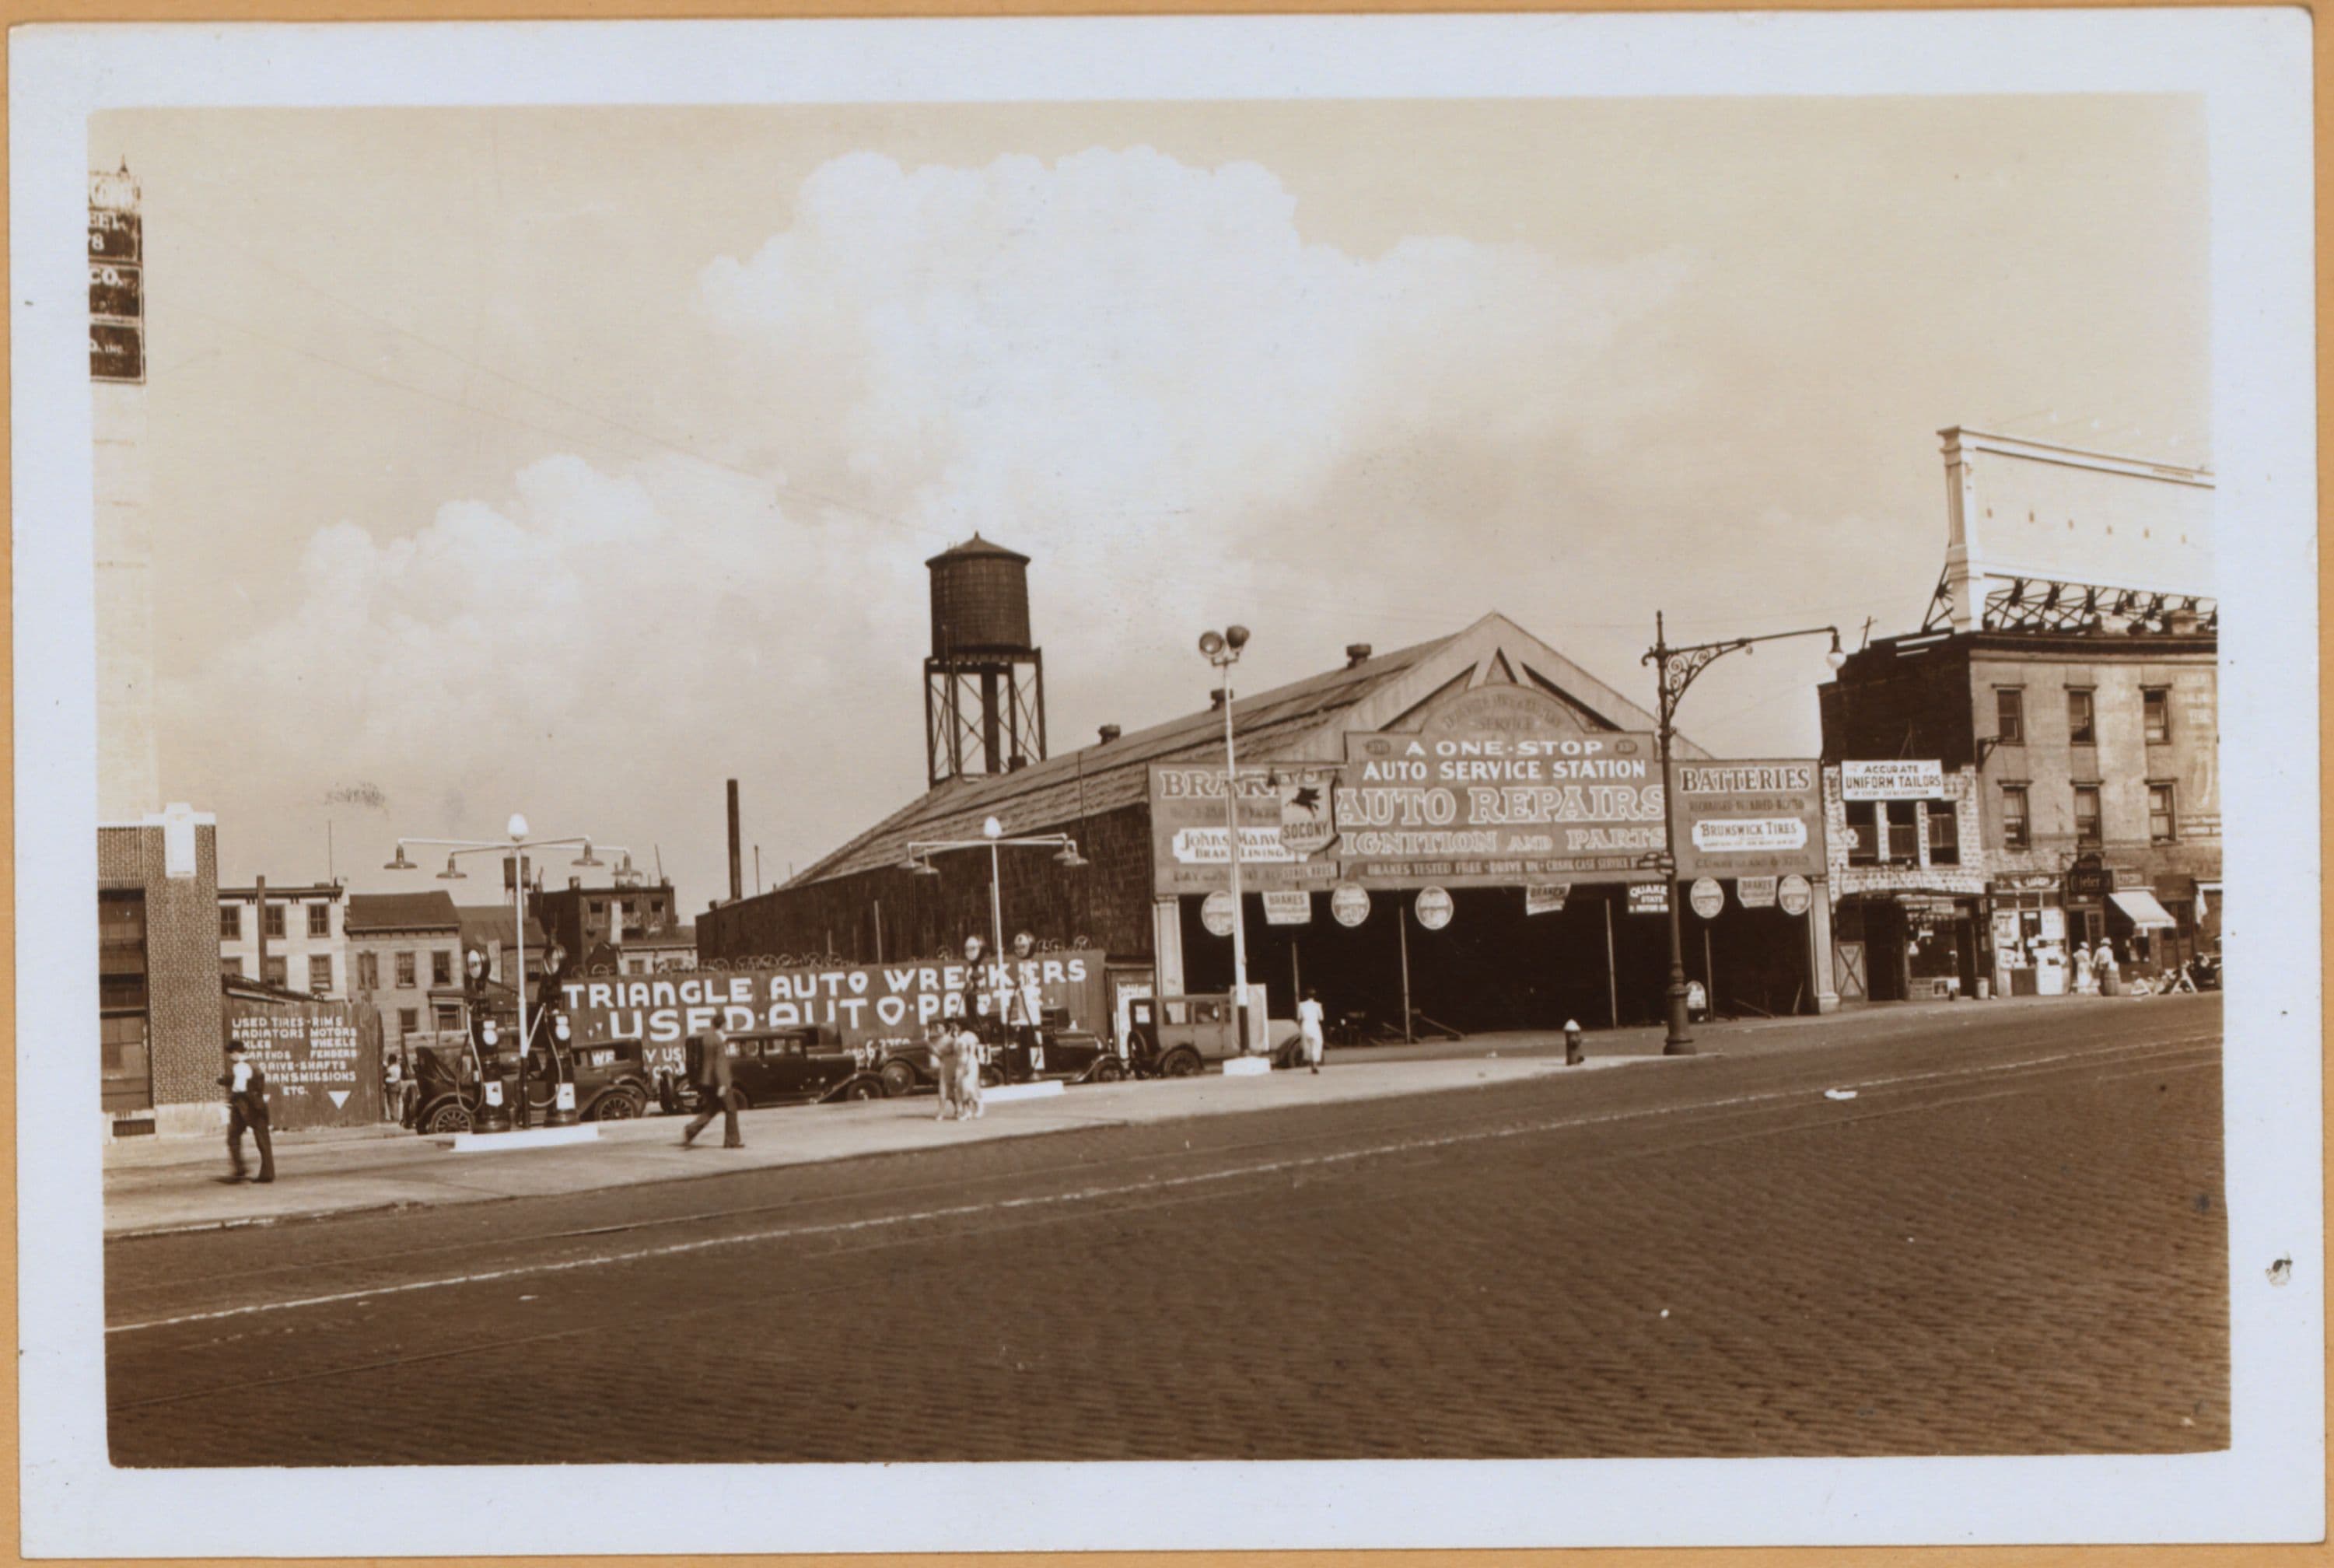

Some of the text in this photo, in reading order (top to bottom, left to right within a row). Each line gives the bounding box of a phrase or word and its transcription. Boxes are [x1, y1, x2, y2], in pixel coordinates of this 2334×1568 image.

[1405, 740, 1426, 755] A
[1363, 758, 1646, 780] AUTO SERVICE STATION
[1864, 765, 1919, 774] ACCURATE
[1680, 765, 1811, 794] BATTERIES
[1845, 775, 1941, 789] UNIFORM TAILORS
[1335, 784, 1665, 827] AUTO REPAIRS
[1283, 821, 1328, 839] SOCONY
[1699, 821, 1797, 837] BRUNSWICK TIRES
[1340, 826, 1667, 856] IGNITION AND PARTS
[1367, 862, 1411, 876] BRAKES
[1412, 861, 1452, 875] TESTED
[1575, 858, 1594, 870] CASE
[1597, 857, 1629, 870] SERVICE
[1640, 895, 1664, 904] STATE
[562, 977, 754, 1010] TRIANGLE
[769, 971, 869, 1000] AUTO
[884, 958, 1087, 993] WRECKERS
[232, 1017, 268, 1028] USED
[232, 1027, 358, 1040] RADIATORS MOTORS
[242, 1038, 357, 1049] XLES WHEELS
[264, 1051, 292, 1060] ENDS
[310, 1048, 358, 1059] FENDERS
[264, 1071, 357, 1083] RANSMISSIONS
[282, 1085, 309, 1096] ETC.
